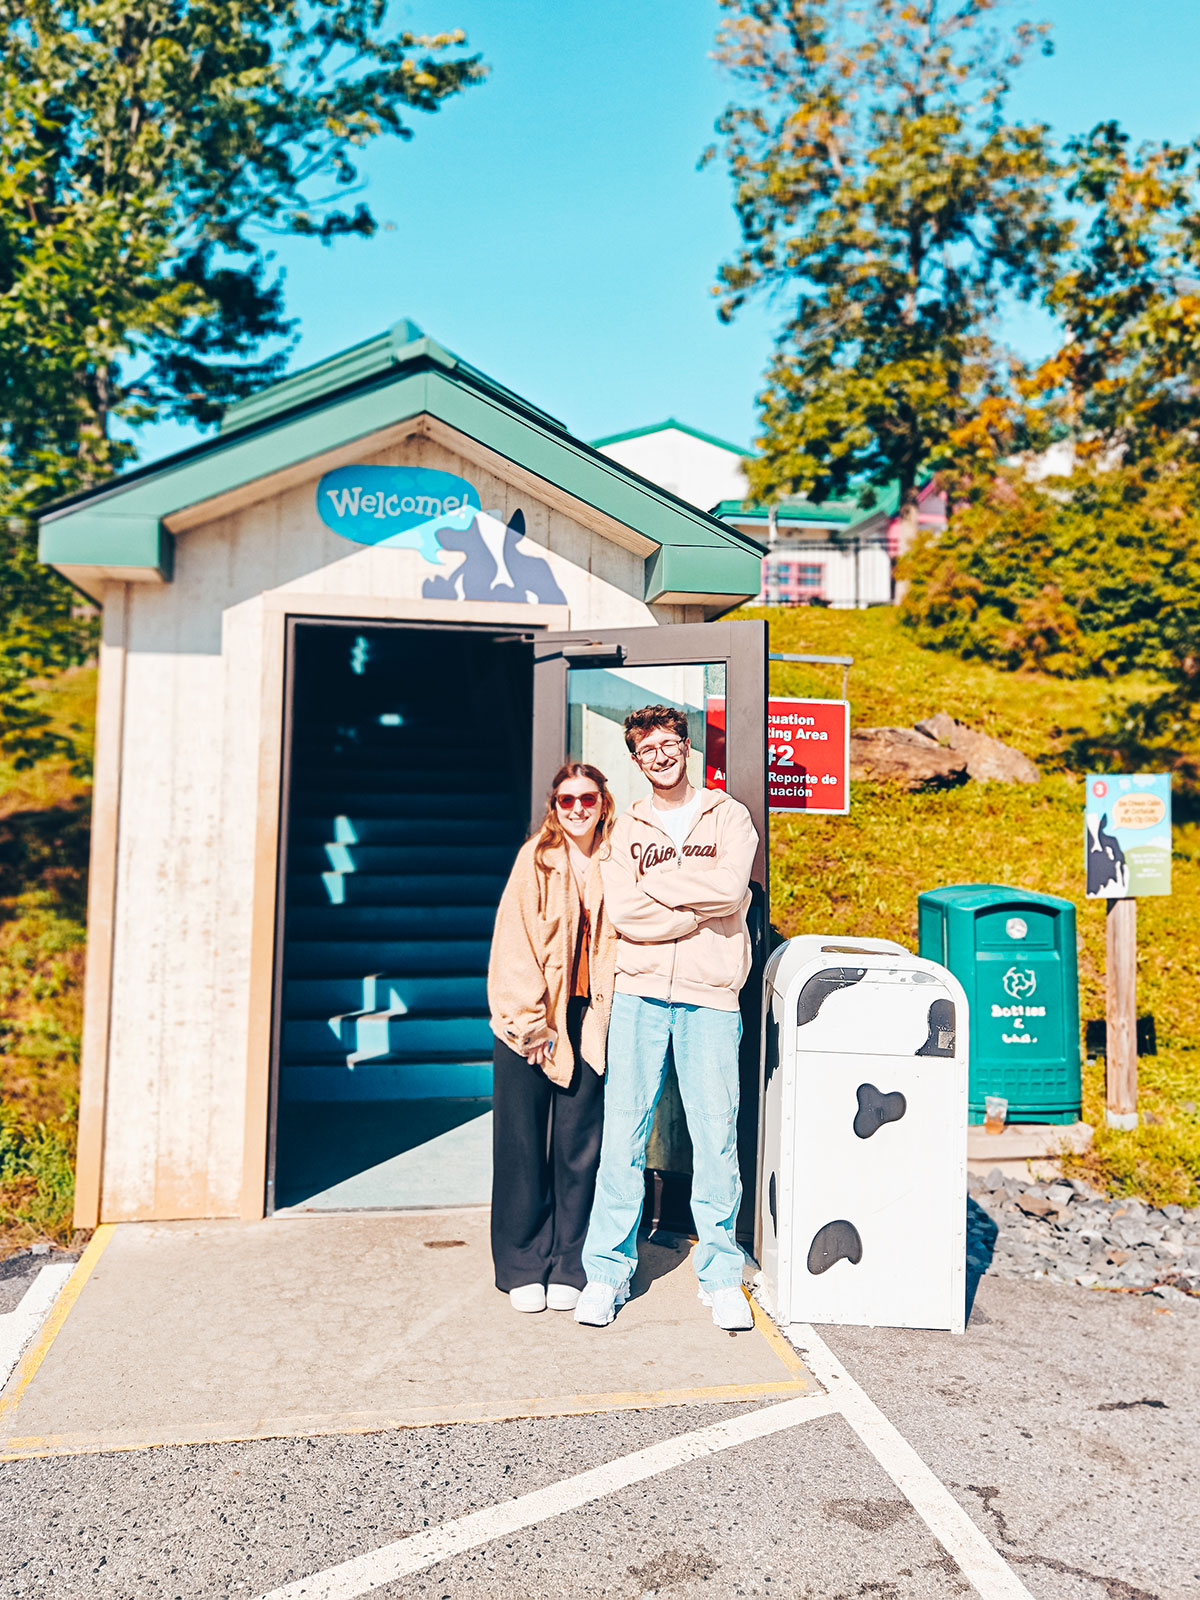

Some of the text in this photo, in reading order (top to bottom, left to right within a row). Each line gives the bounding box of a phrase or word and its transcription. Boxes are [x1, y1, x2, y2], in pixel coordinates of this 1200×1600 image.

[326, 486, 469, 519] Welcome!
[795, 727, 828, 741] Area
[768, 771, 819, 786] Reporte
[821, 773, 838, 785] de
[768, 785, 813, 798] uación
